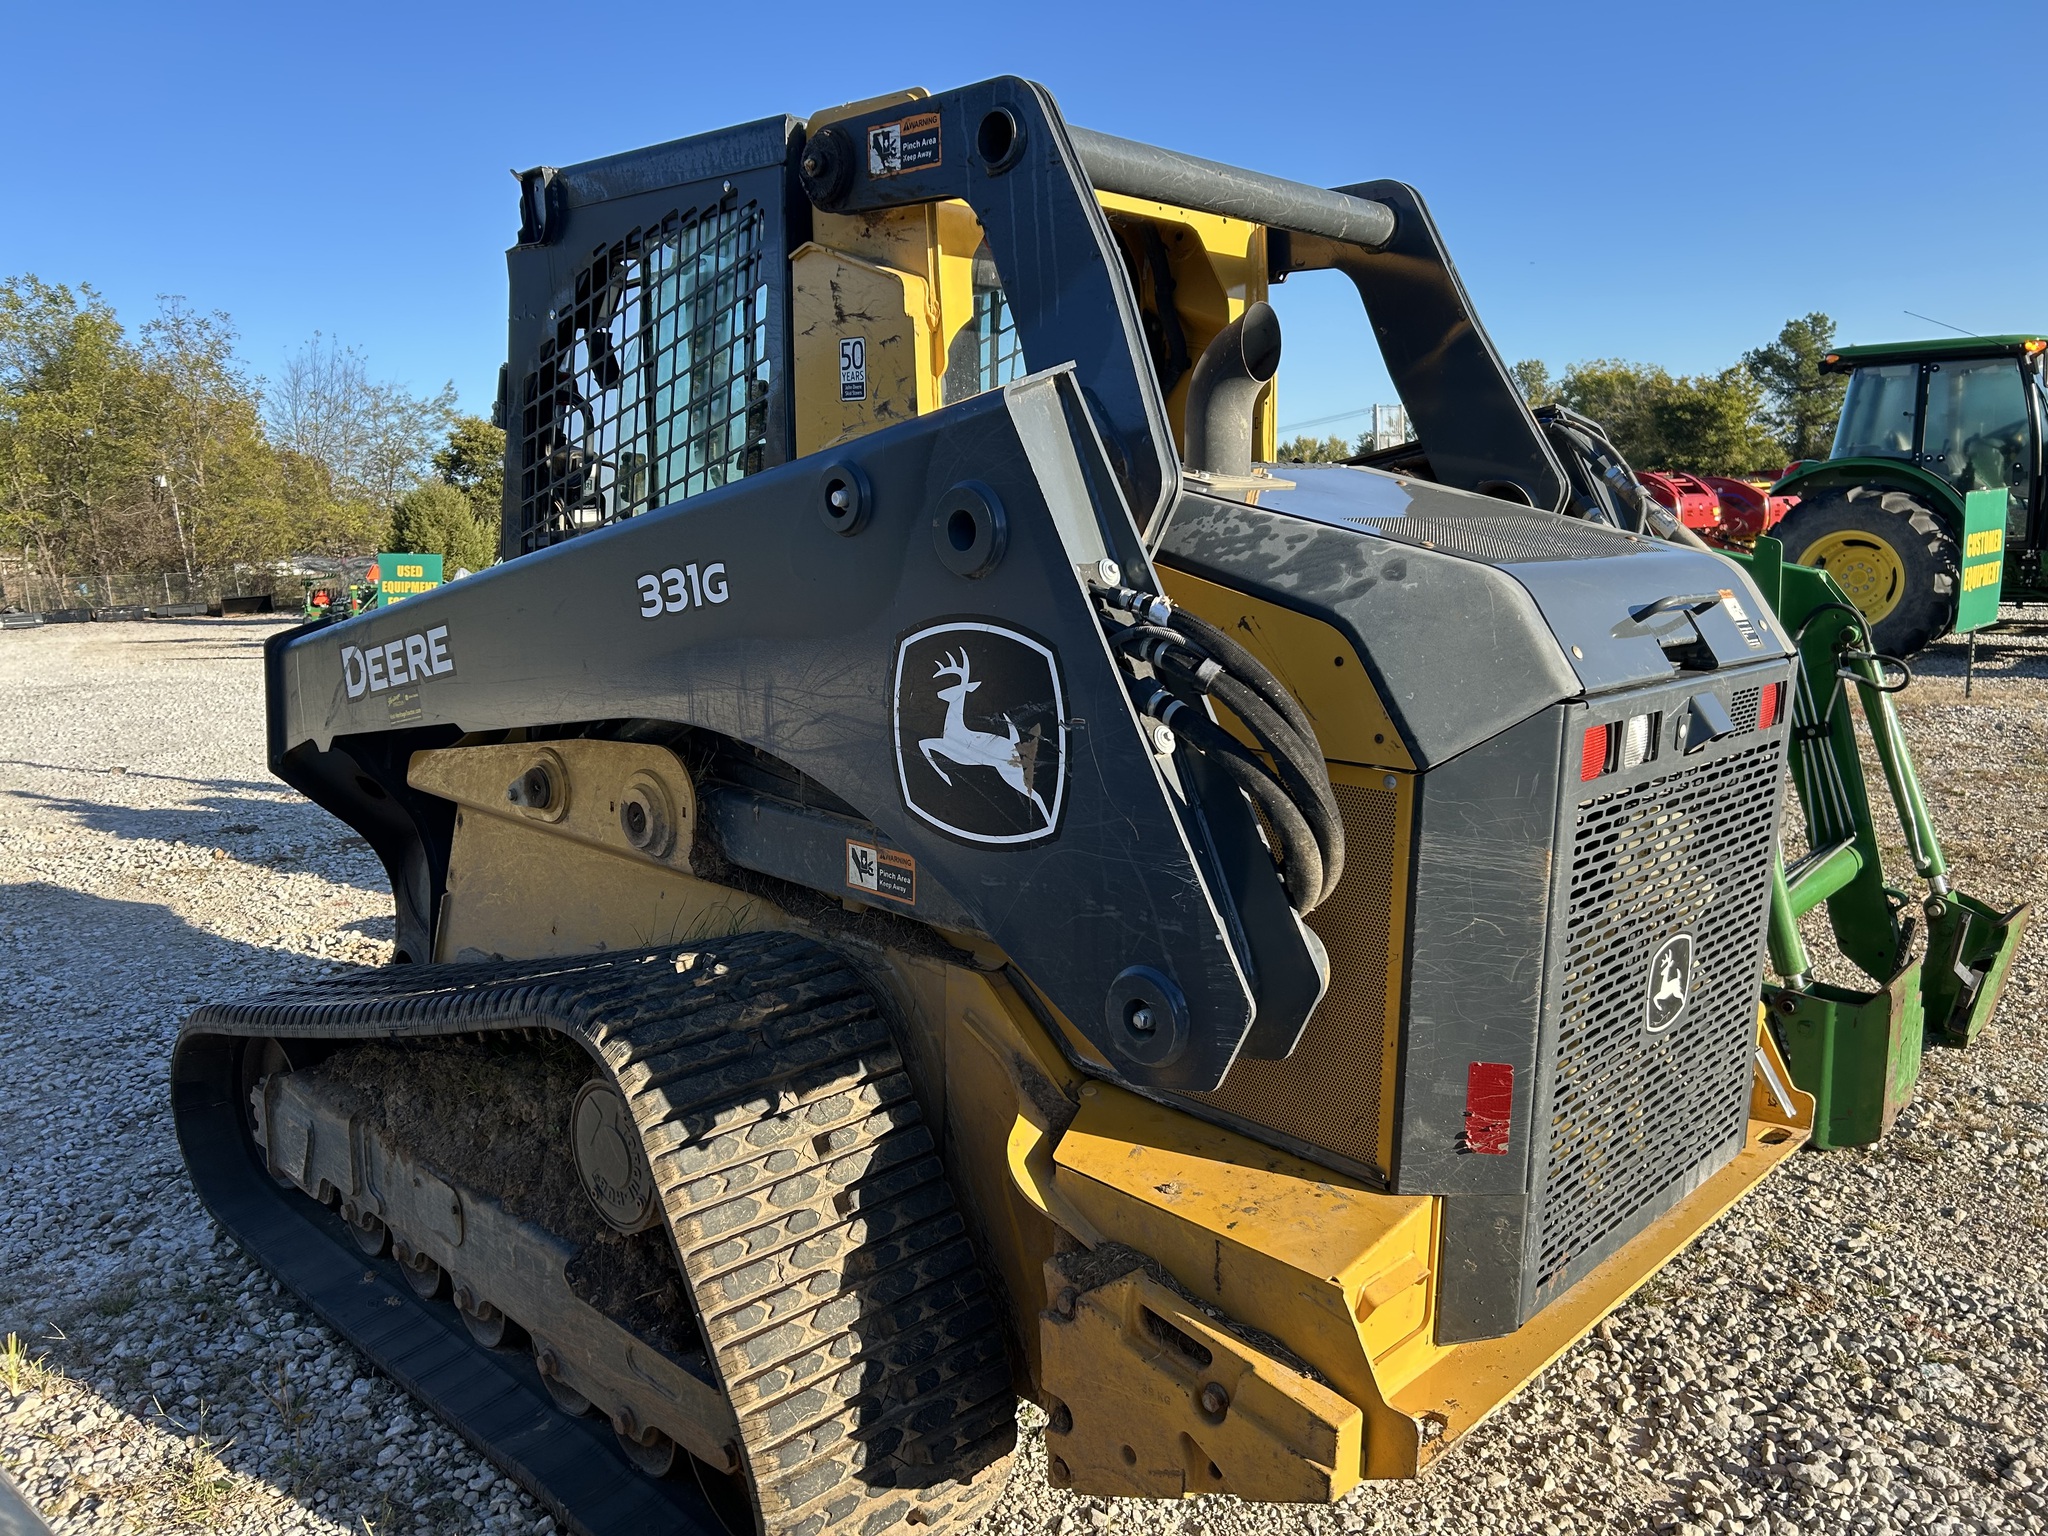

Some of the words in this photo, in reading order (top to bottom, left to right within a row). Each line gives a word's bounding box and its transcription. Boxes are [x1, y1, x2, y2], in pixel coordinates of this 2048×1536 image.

[909, 115, 938, 129] WARNING
[902, 139, 921, 151] Pinch
[921, 136, 937, 147] Area
[917, 150, 932, 159] Away
[841, 341, 864, 371] 50
[842, 370, 865, 381] YEARS
[1966, 528, 2003, 558] CUSTOMER
[396, 565, 423, 577] USED
[1963, 560, 2001, 593] EQUIPMENT
[637, 563, 729, 618] 331G
[341, 625, 453, 698] DEERE
[885, 854, 912, 867] WARNING
[880, 869, 896, 880] Pinch
[897, 873, 911, 884] Area
[879, 880, 892, 889] Keep
[892, 883, 907, 894] Away
